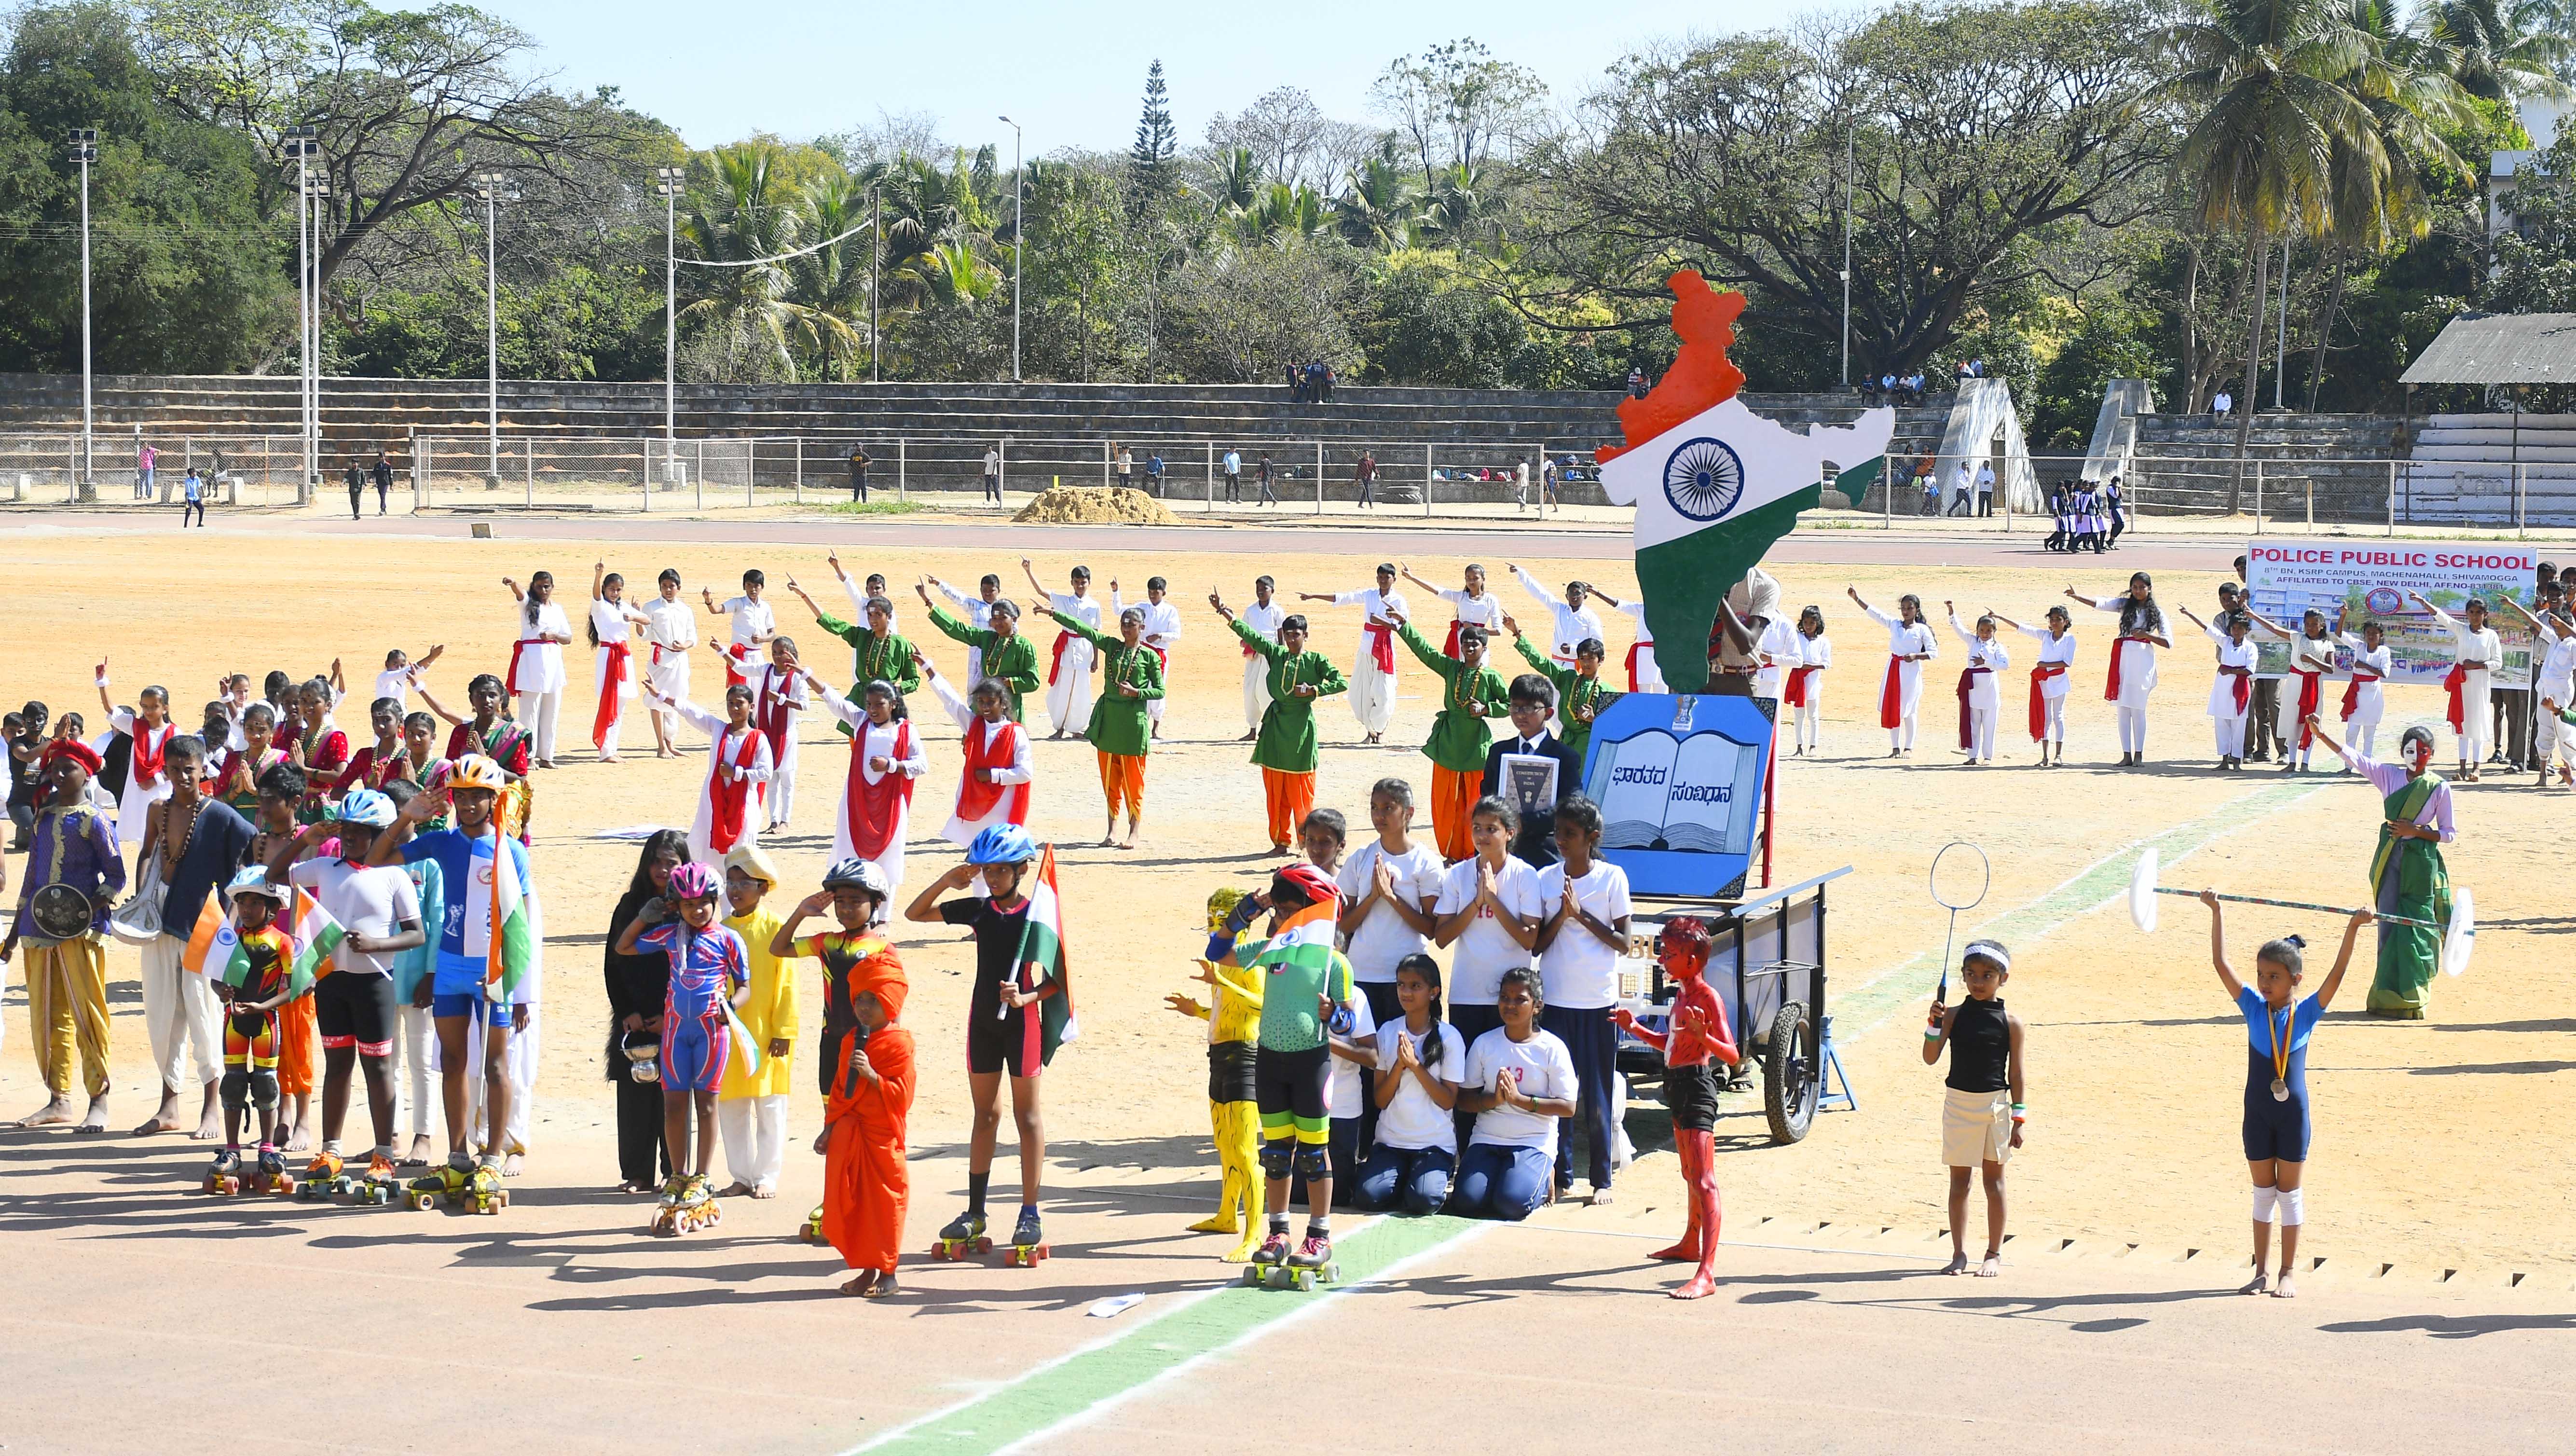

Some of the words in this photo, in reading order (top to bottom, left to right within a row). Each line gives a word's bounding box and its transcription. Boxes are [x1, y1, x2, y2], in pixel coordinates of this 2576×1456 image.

[2251, 548, 2333, 563] POLICE
[2341, 551, 2427, 566] PUBLIC
[2434, 554, 2535, 570] SCHOOL
[2326, 569, 2368, 577] CAMPUS,
[2370, 571, 2449, 580] MACHENAHALLI,
[2452, 574, 2518, 582] SHIVAMOGGA
[1613, 764, 1667, 786] ಭಾರತದ
[1671, 781, 1733, 806] ಸಂವಿಧಾನ
[1478, 903, 1494, 919] 16
